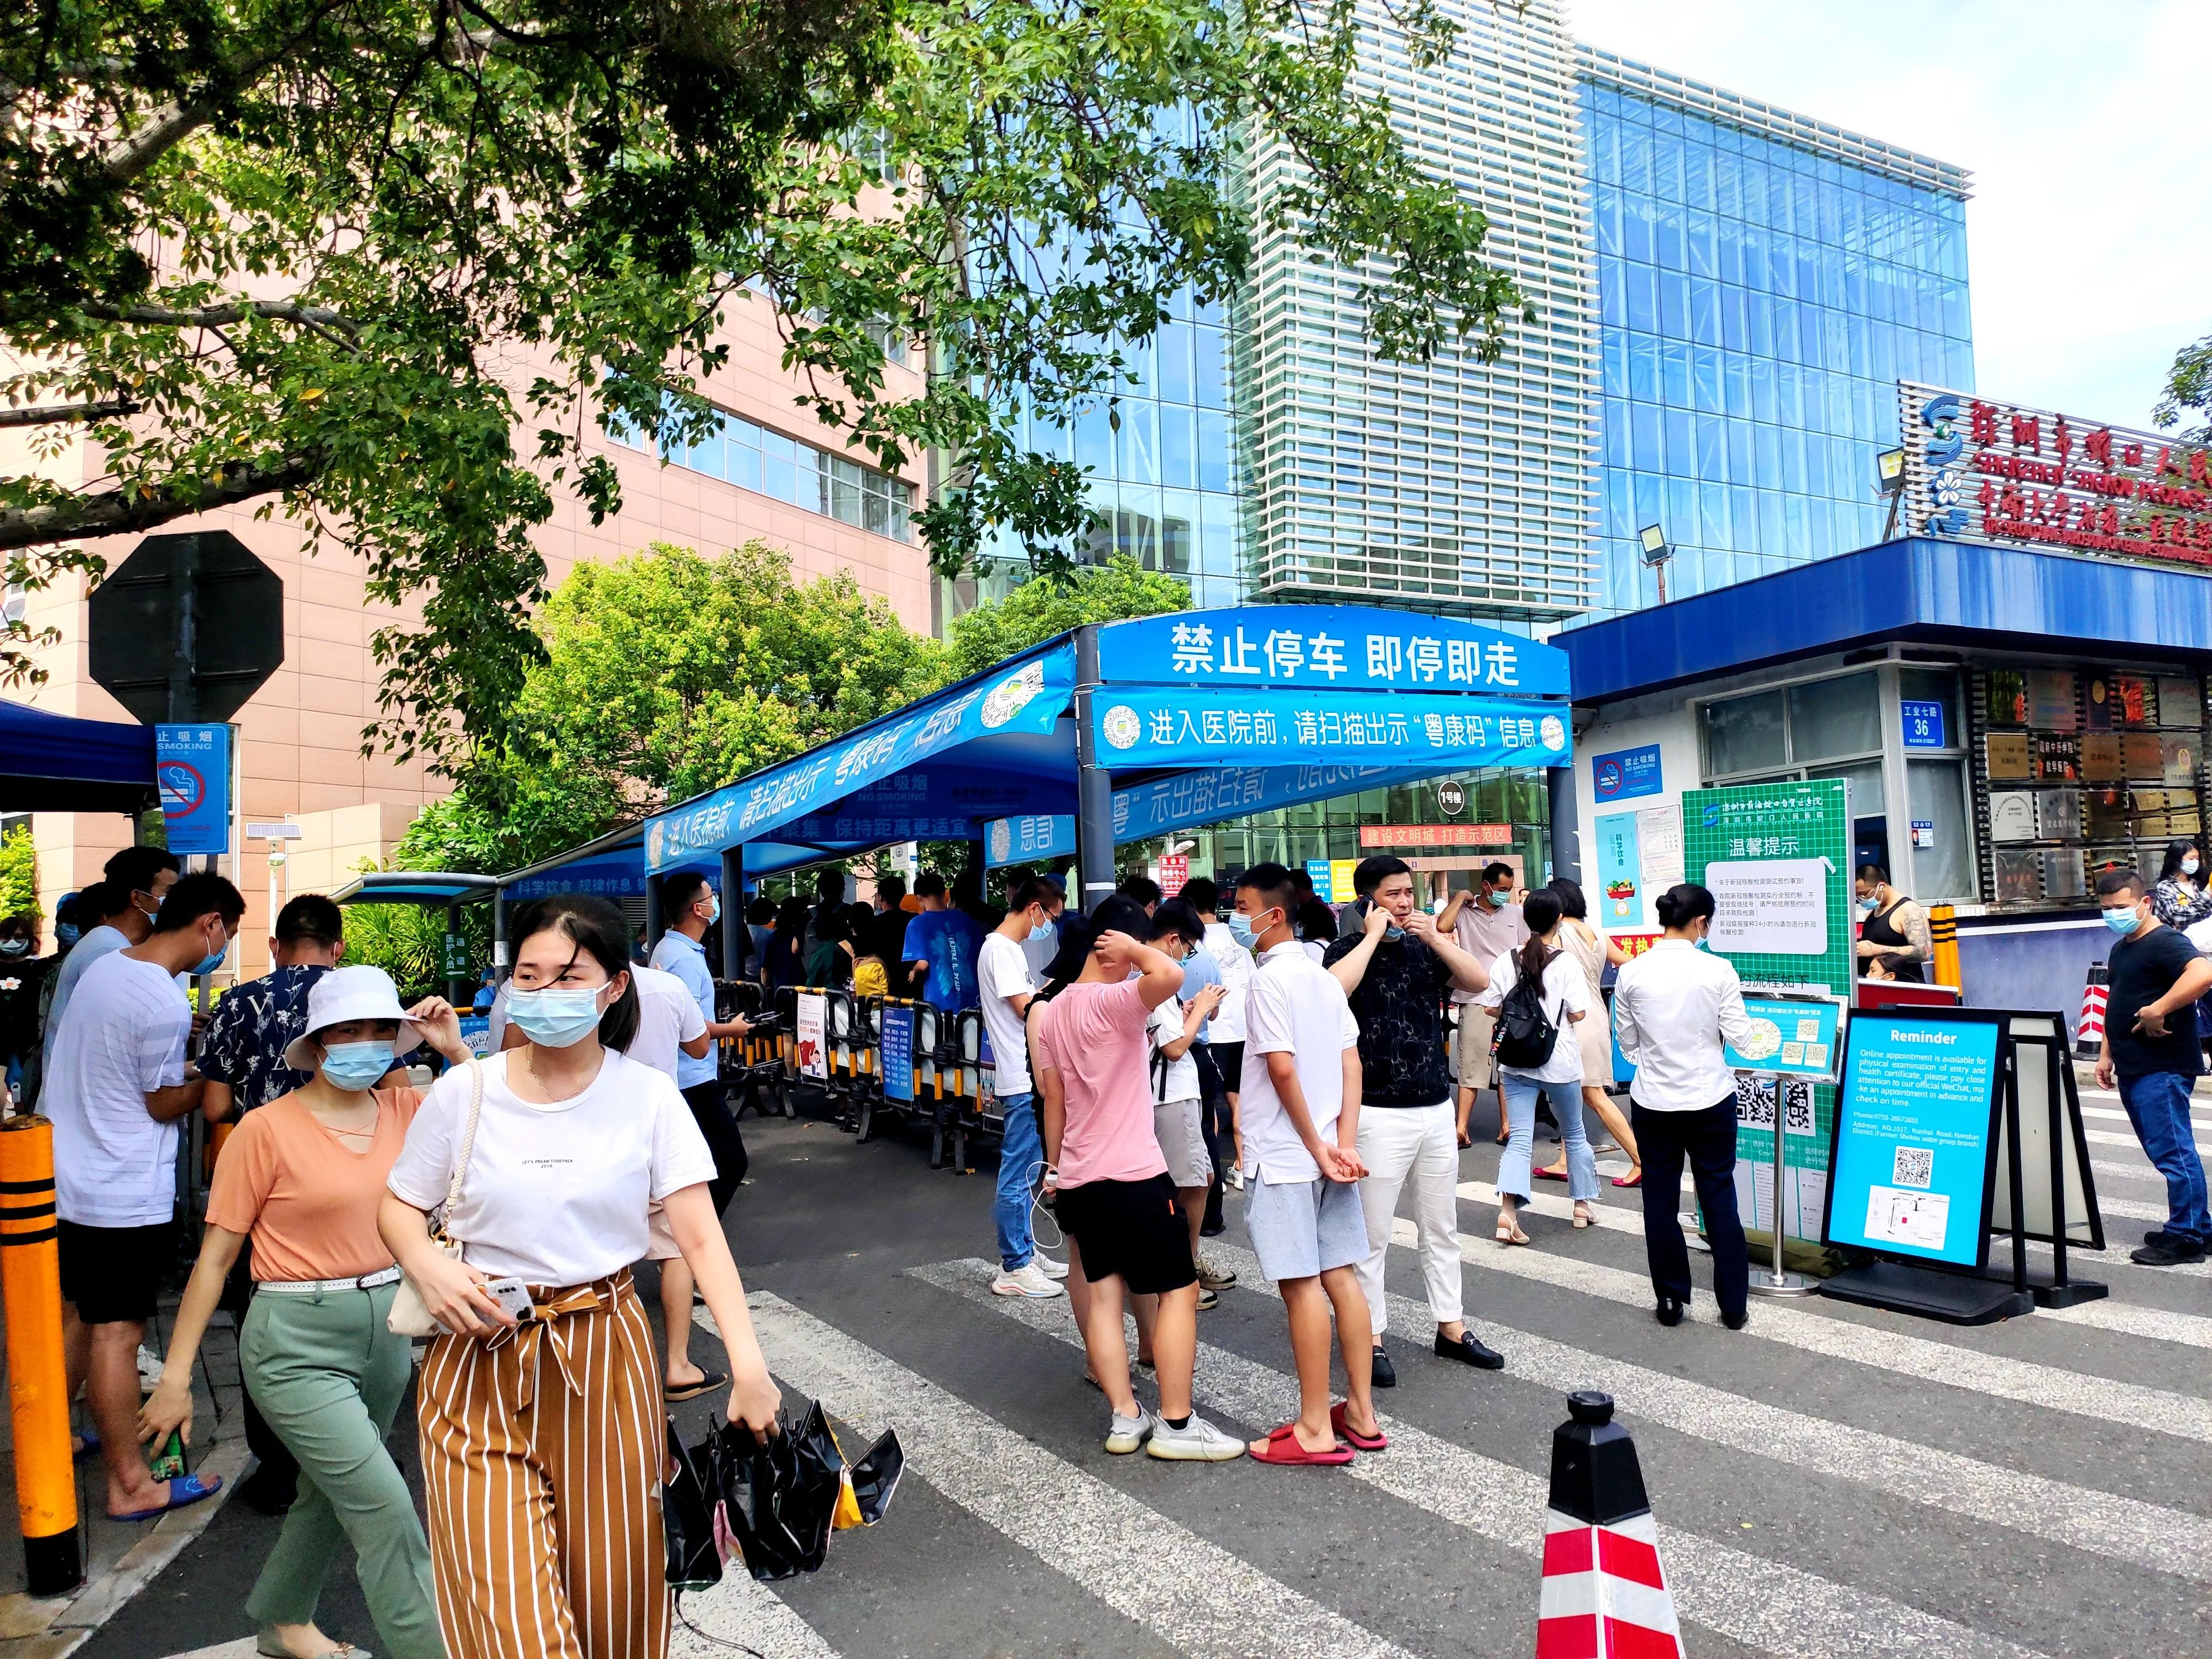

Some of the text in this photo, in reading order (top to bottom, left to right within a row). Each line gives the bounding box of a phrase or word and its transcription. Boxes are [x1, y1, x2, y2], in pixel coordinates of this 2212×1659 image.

[1171, 622, 1520, 687] 禁止停车 即停即走
[1904, 706, 1937, 717] 工业七路
[1914, 718, 1929, 736] 36
[1632, 763, 1655, 771] SMOKING
[858, 792, 927, 801] NO SMOKING
[1441, 791, 1462, 804] 1号楼
[834, 818, 968, 838] 保持距离更适宜
[1367, 827, 1506, 844] 建设文明城 打造示范区
[1615, 833, 1624, 867] 科学饮食
[1729, 836, 1799, 857] 温馨提示
[517, 880, 572, 895] 科学饮食
[579, 879, 632, 893] 规律作息
[446, 934, 455, 969] 医护人员
[1891, 1029, 1958, 1045] Reminder
[1860, 1049, 1884, 1058] Online
[1886, 1052, 1932, 1062] appointment
[1942, 1055, 1975, 1065] available
[1976, 1056, 1986, 1065] for
[1859, 1058, 1888, 1068] physical
[1892, 1061, 1936, 1071] examination
[1950, 1065, 1969, 1074] entry
[1859, 1067, 1881, 1076] health
[1924, 1072, 1948, 1083] please
[1950, 1075, 1964, 1083] pay
[1858, 1076, 1890, 1086] attention
[1916, 1080, 1940, 1090] official
[1941, 1083, 1971, 1094] WeChat,
[1856, 1094, 1879, 1103] check
[1892, 1098, 1911, 1107] time.
[1881, 1088, 1928, 1099] appointment
[1938, 1093, 1968, 1102] advance
[1970, 1094, 1984, 1103] and
[1852, 1121, 1879, 1130] Address:
[1912, 1128, 1933, 1136] Nanhai
[1899, 1133, 1921, 1141] Shekou
[1938, 1138, 1956, 1146] group
